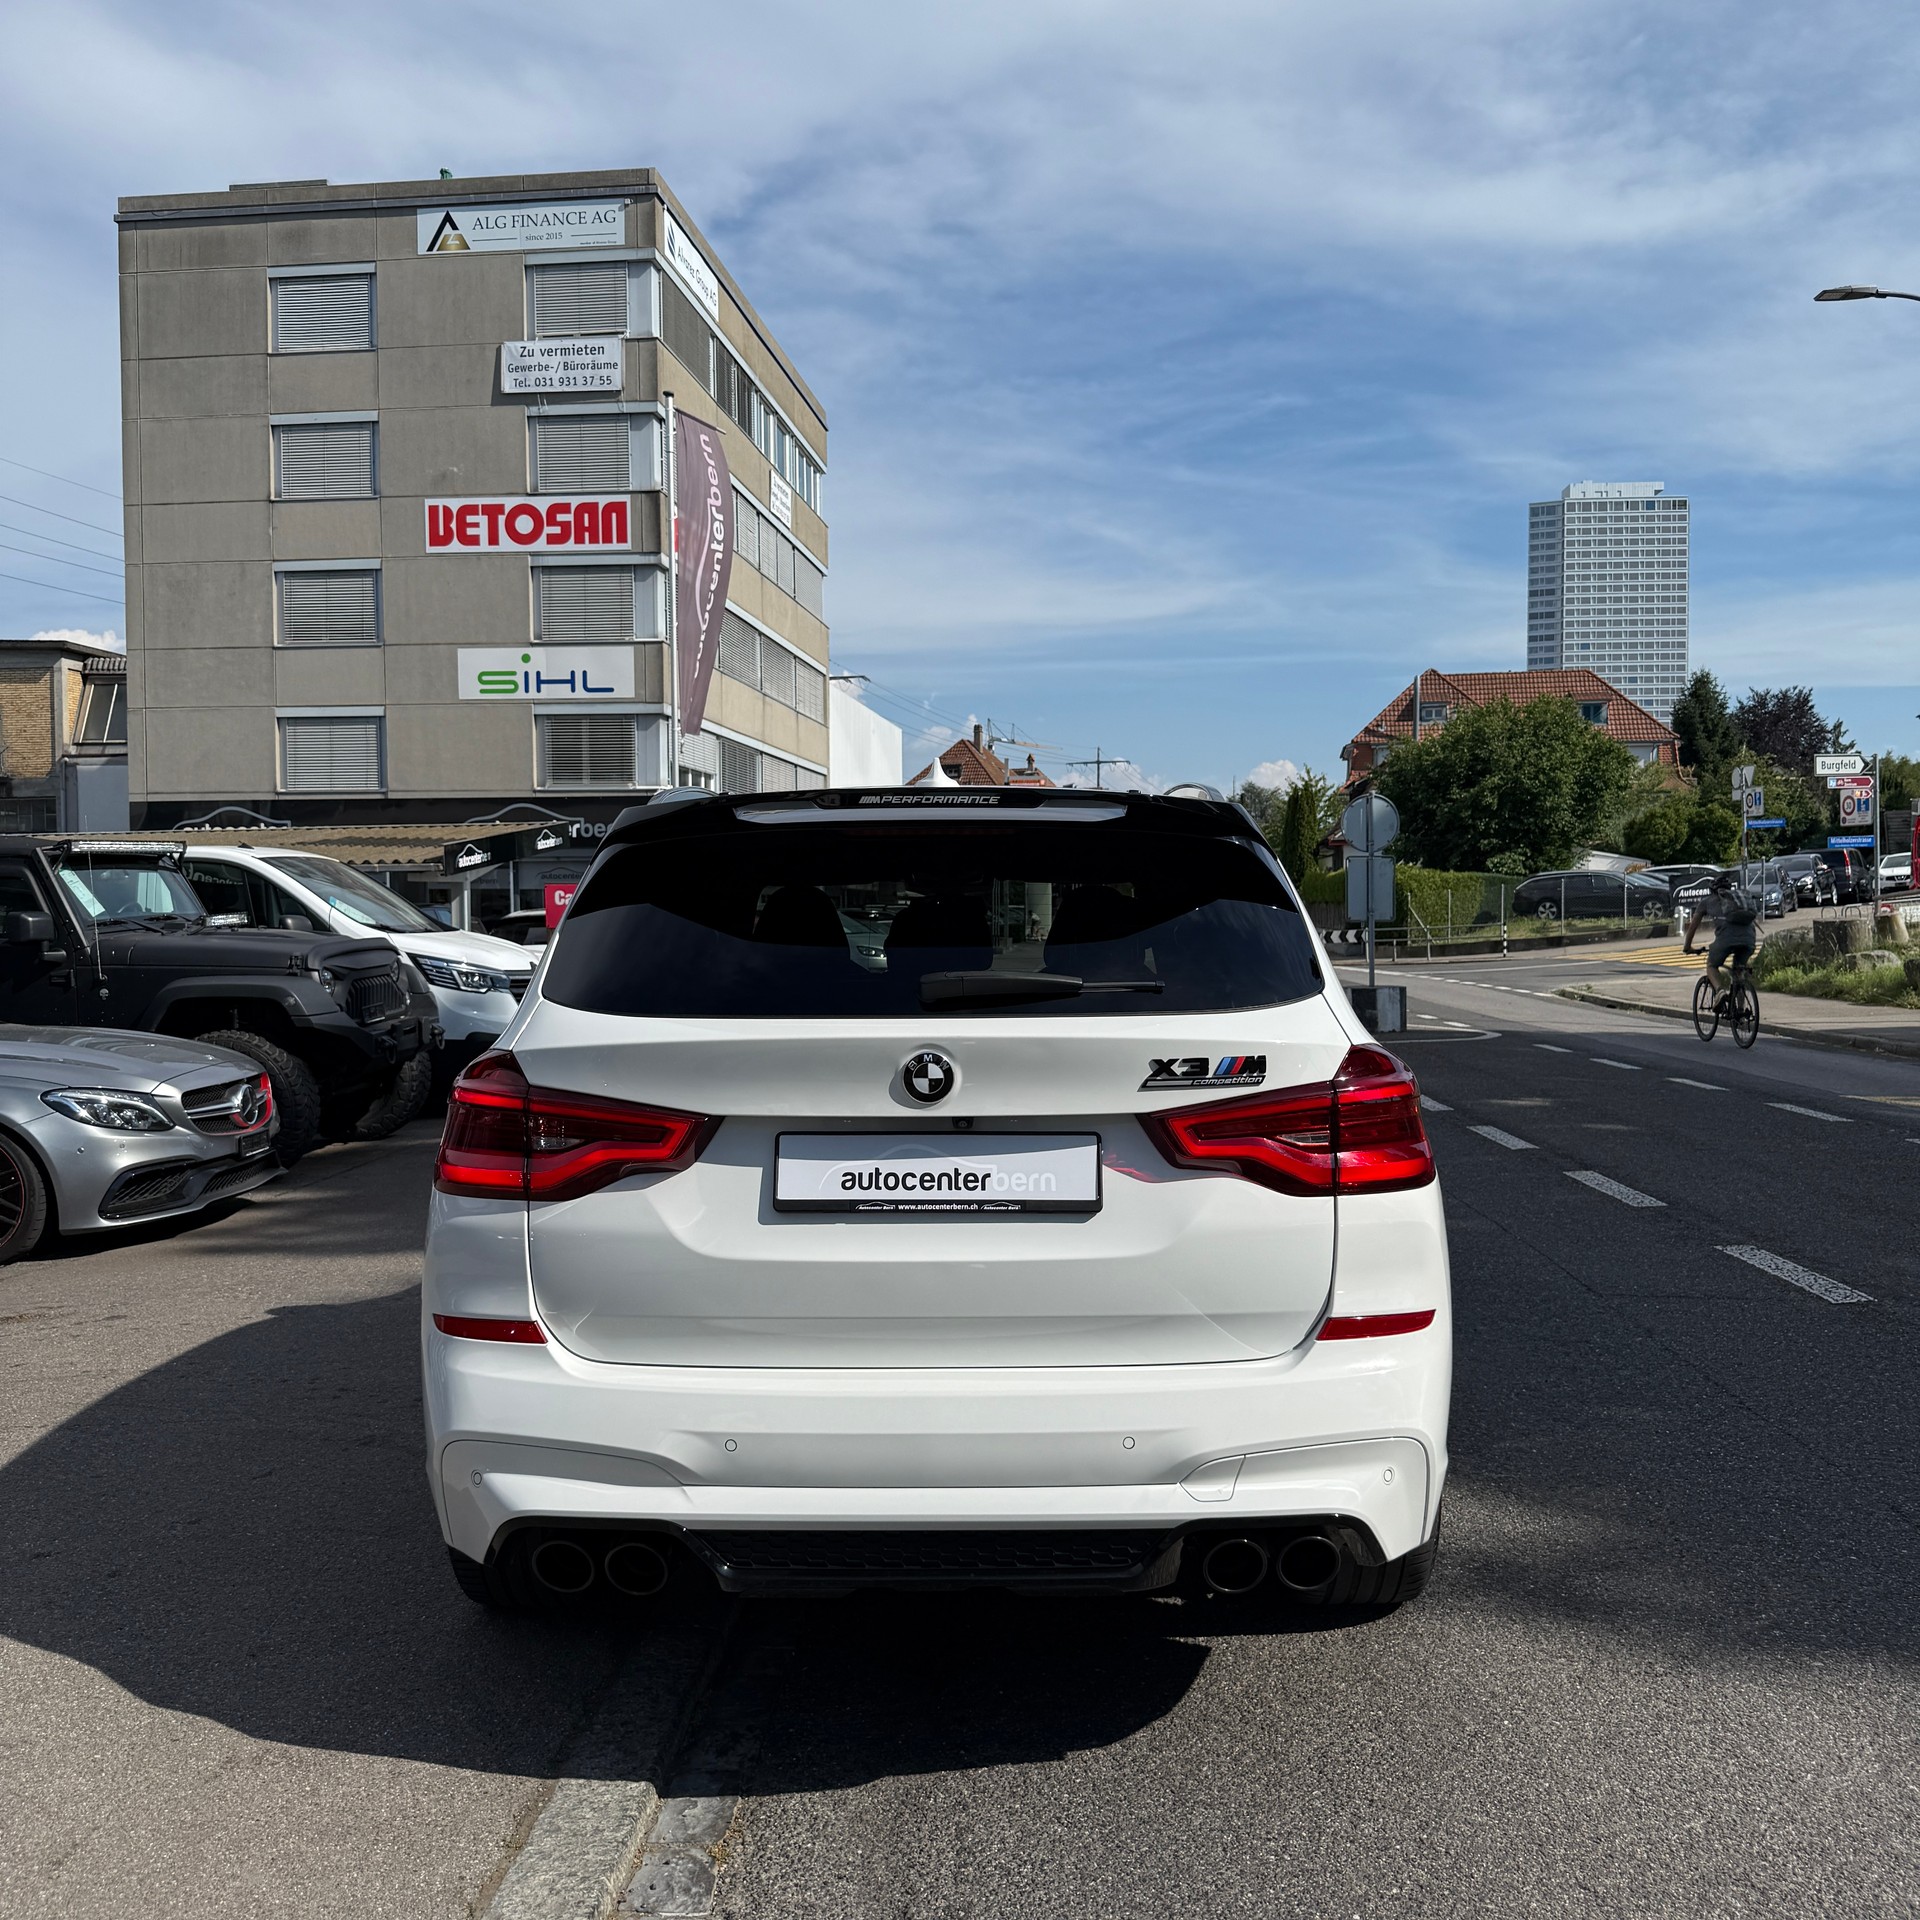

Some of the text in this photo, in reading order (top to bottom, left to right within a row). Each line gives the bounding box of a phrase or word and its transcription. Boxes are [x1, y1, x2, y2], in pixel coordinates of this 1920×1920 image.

[472, 209, 617, 231] ALG FINANCE AG
[525, 232, 563, 241] since 2015
[695, 269, 709, 300] Group
[519, 344, 605, 358] Zu vermieten
[563, 360, 619, 371] Büroräume
[513, 375, 613, 388] Tel. 031 931 37 55
[428, 501, 629, 547] BETOSAN
[1821, 760, 1857, 772] Burgfeld
[907, 1054, 950, 1071] BMW
[1148, 1057, 1210, 1078] X3
[1193, 1077, 1264, 1086] competition
[898, 1203, 979, 1211] www.autocenterbern.ch
